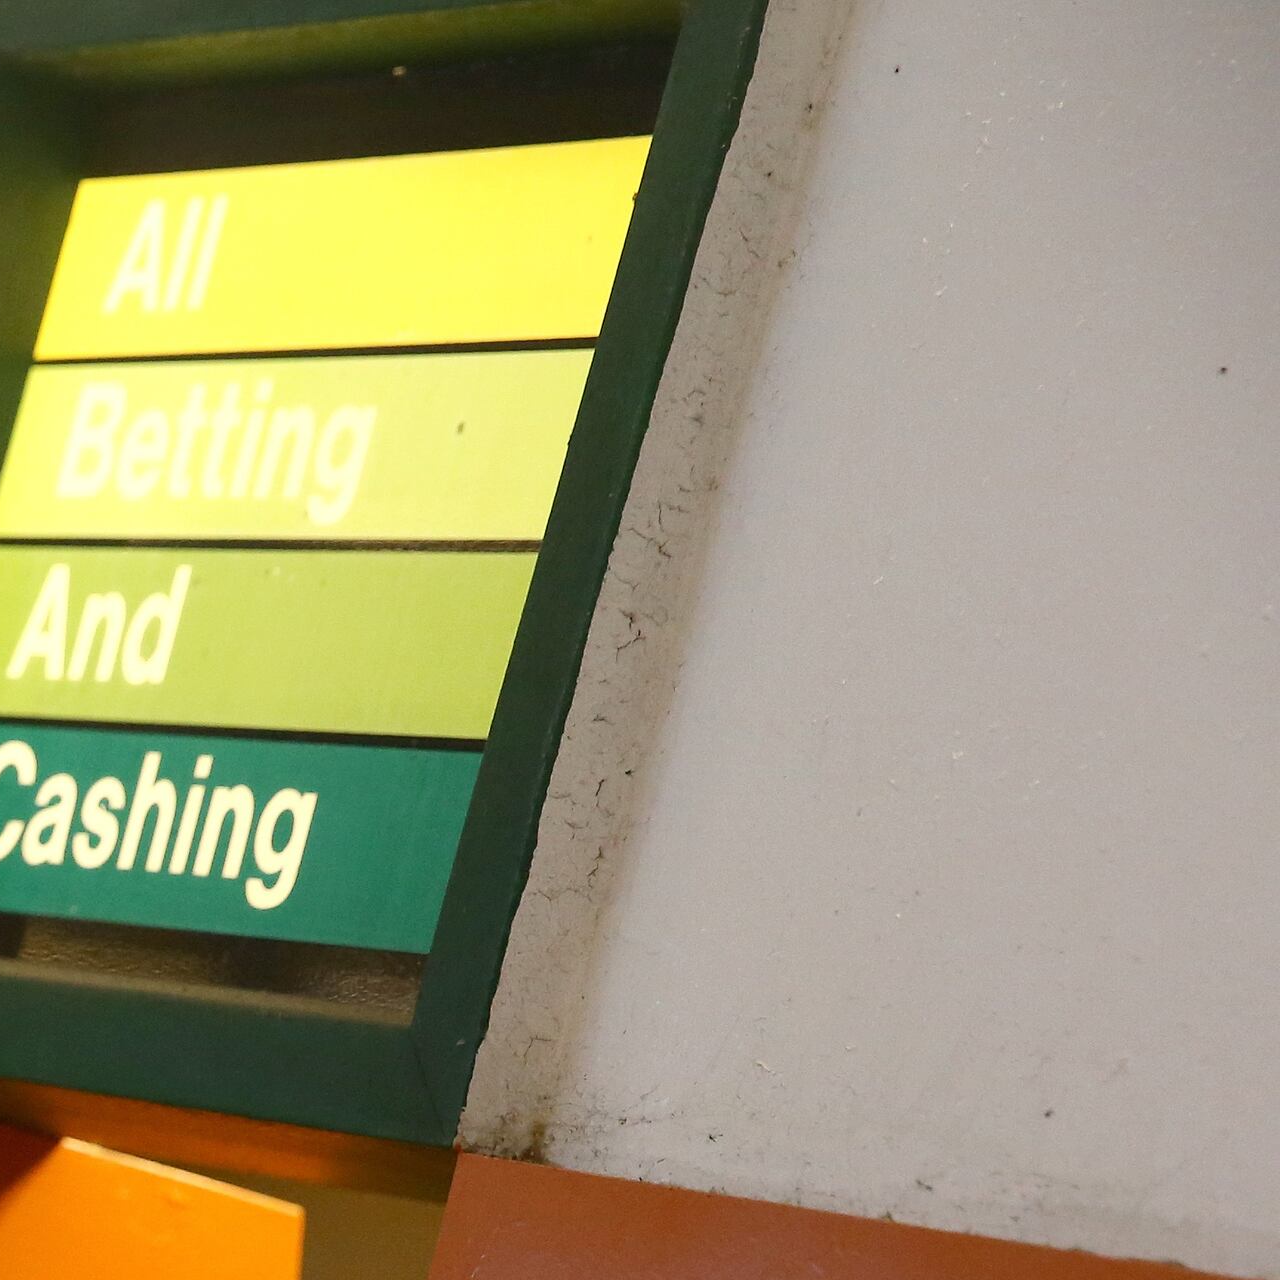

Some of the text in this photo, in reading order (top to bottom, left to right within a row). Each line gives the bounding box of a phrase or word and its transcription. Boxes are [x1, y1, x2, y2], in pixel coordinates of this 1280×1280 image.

[103, 195, 227, 312] All
[56, 380, 375, 526] Betting
[6, 563, 192, 685] And
